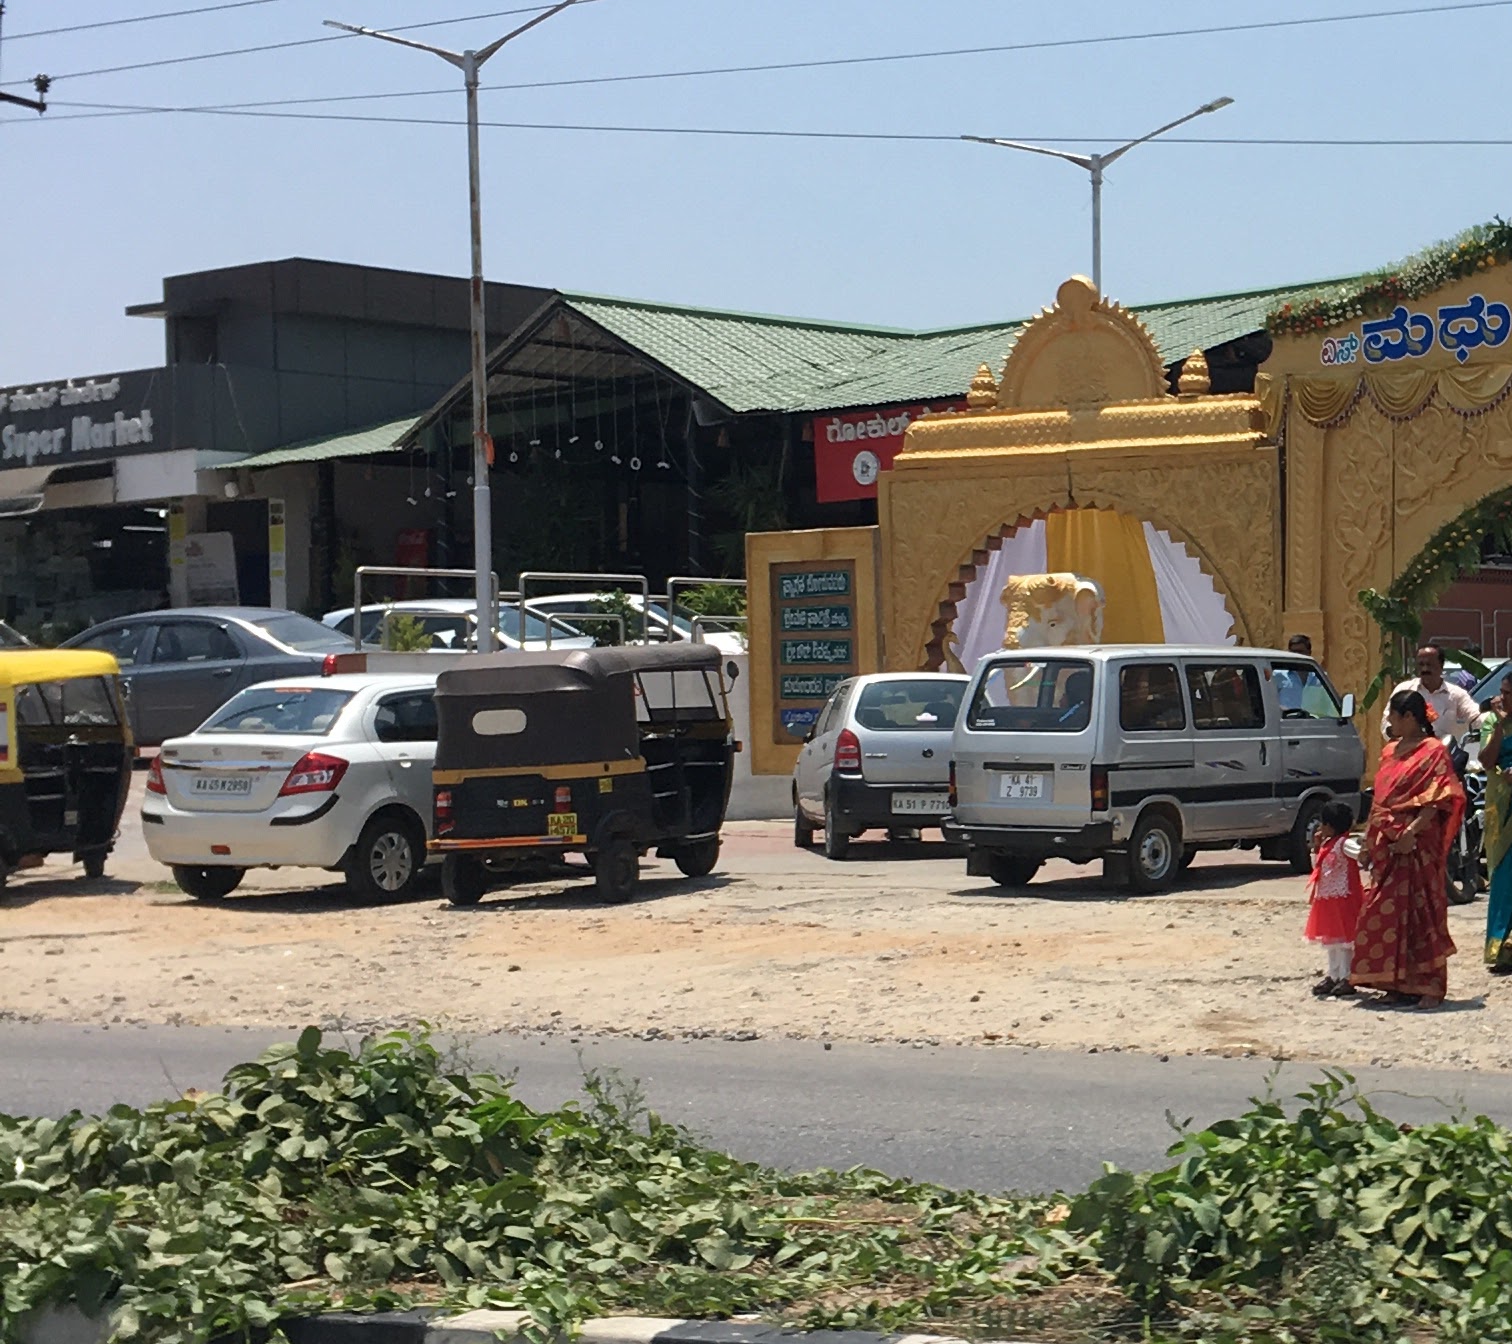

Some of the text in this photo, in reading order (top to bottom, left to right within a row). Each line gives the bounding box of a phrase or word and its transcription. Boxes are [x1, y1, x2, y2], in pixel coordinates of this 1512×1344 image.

[1361, 293, 1512, 364] ಮಧು
[2, 409, 153, 466] Super Market
[826, 411, 911, 443] ಗೋಕುಲ್
[1011, 774, 1022, 785] KA
[893, 799, 903, 809] KA
